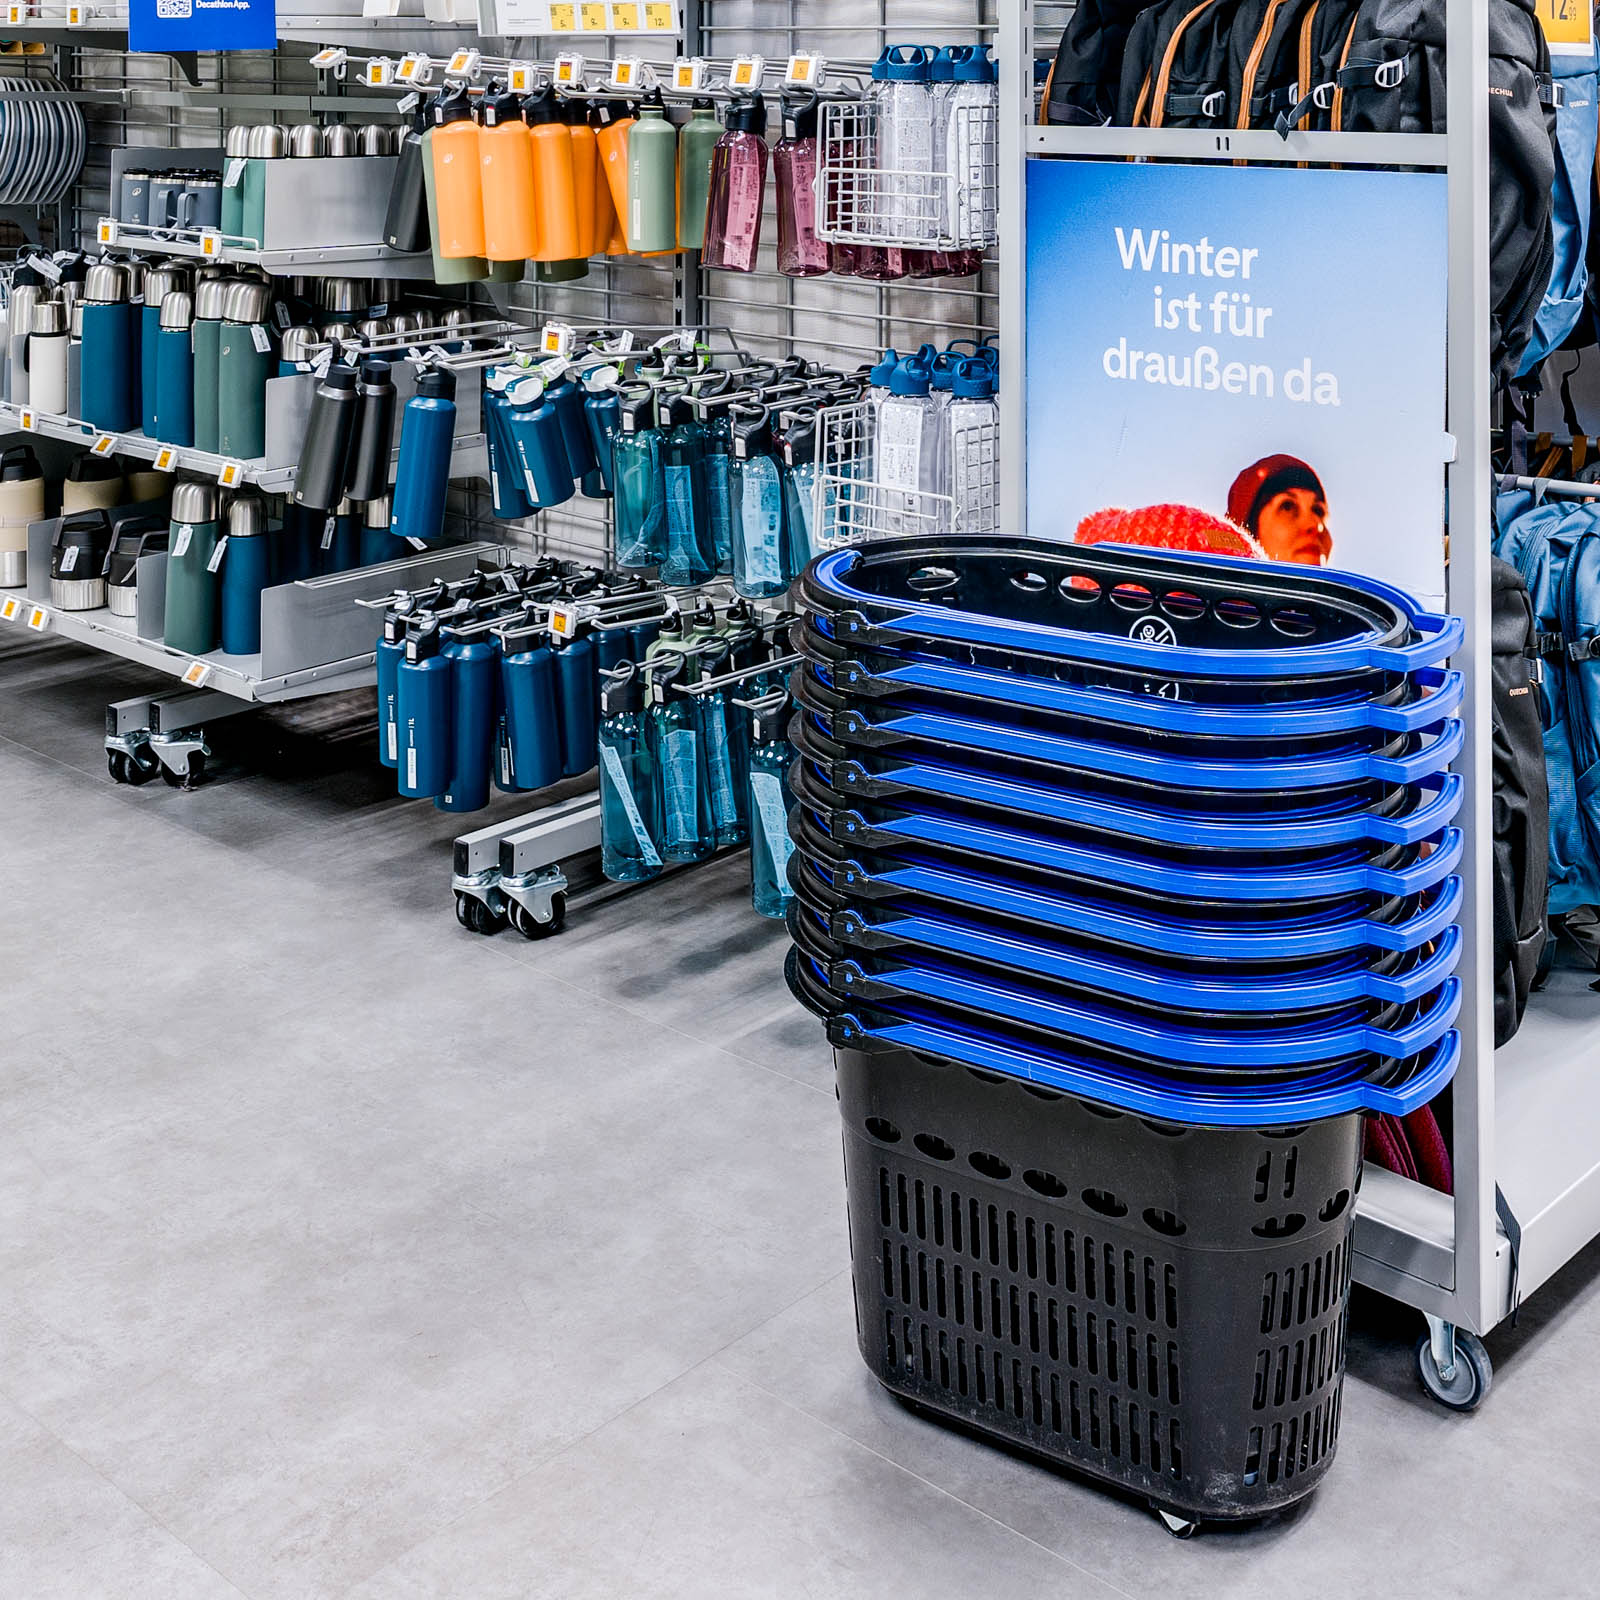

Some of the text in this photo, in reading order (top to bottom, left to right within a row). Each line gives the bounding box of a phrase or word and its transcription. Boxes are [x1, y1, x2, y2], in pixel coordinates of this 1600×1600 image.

[195, 0, 234, 8] Decathlon
[1489, 87, 1513, 97] ECHUA
[1114, 227, 1258, 279] Winter
[1154, 285, 1272, 338] ist für
[1102, 337, 1341, 407] draußen da
